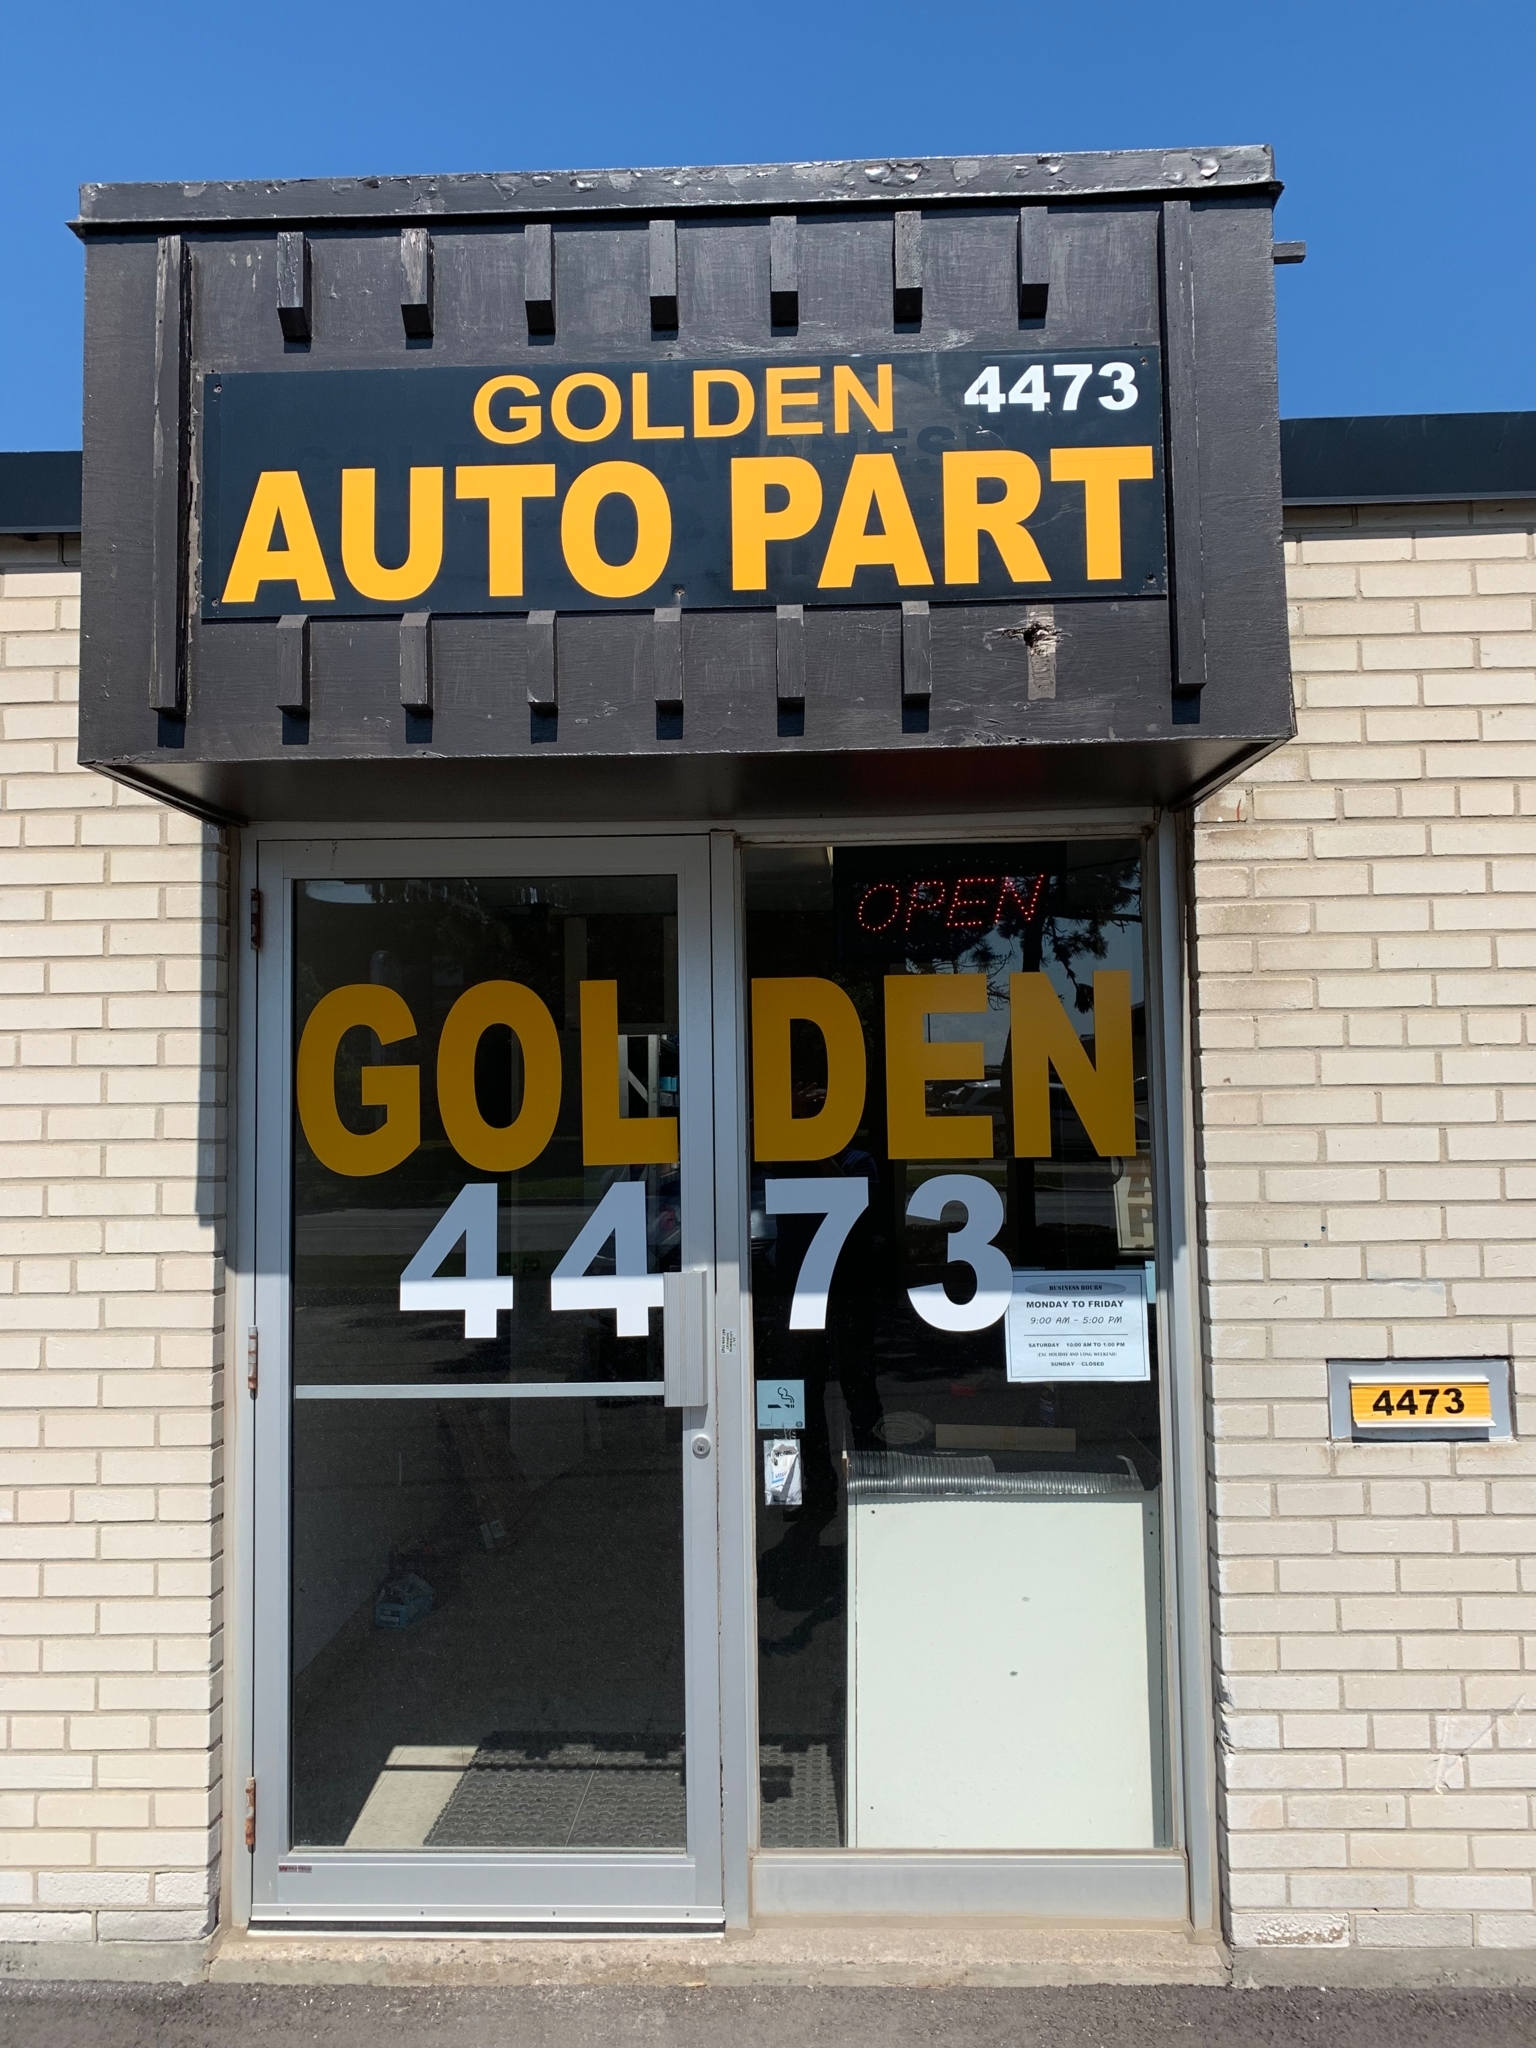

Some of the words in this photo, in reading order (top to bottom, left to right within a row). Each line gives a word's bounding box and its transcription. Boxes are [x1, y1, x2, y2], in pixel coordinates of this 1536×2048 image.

[473, 363, 894, 445] GOLDEN
[963, 361, 1139, 413] 4473
[221, 460, 672, 603] AUTO
[730, 445, 1154, 591] PART
[858, 874, 1045, 931] OPEN
[1082, 1316, 1104, 1324] 5:00
[1088, 1300, 1124, 1308] FRIDAY
[1372, 1387, 1465, 1416] 4473
